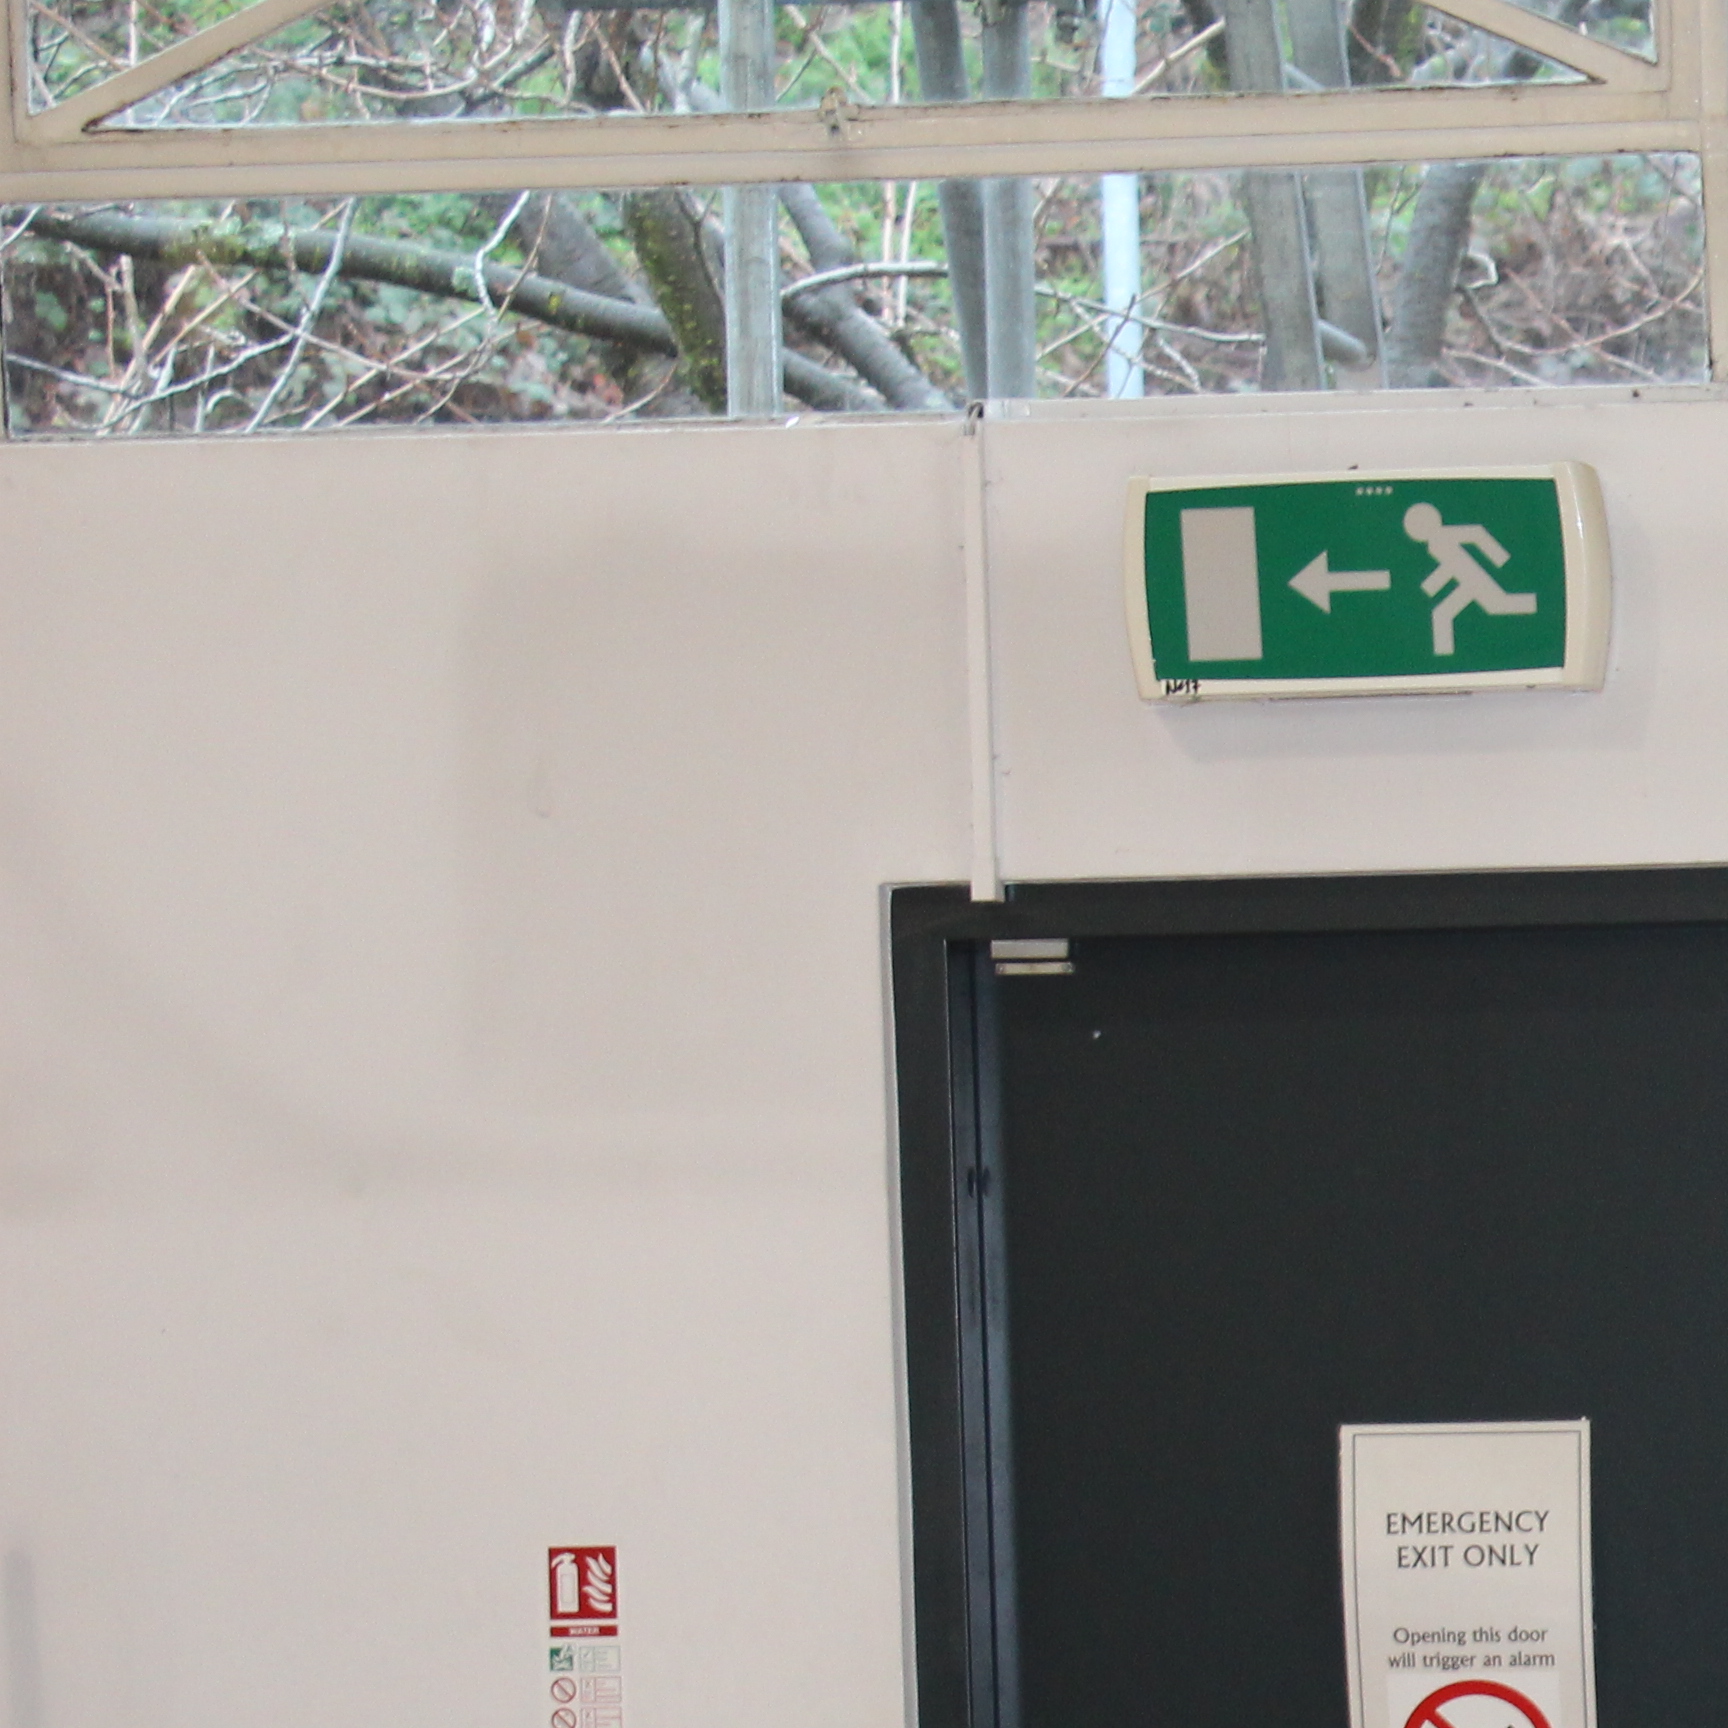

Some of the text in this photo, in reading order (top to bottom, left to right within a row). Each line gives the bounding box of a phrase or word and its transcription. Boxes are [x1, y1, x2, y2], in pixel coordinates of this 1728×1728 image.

[1386, 1510, 1550, 1535] EMERGENCY
[1397, 1543, 1540, 1569] EXIT ONLY
[1393, 1626, 1549, 1646] Opening this door
[1388, 1651, 1556, 1672] will trigger an alarm
